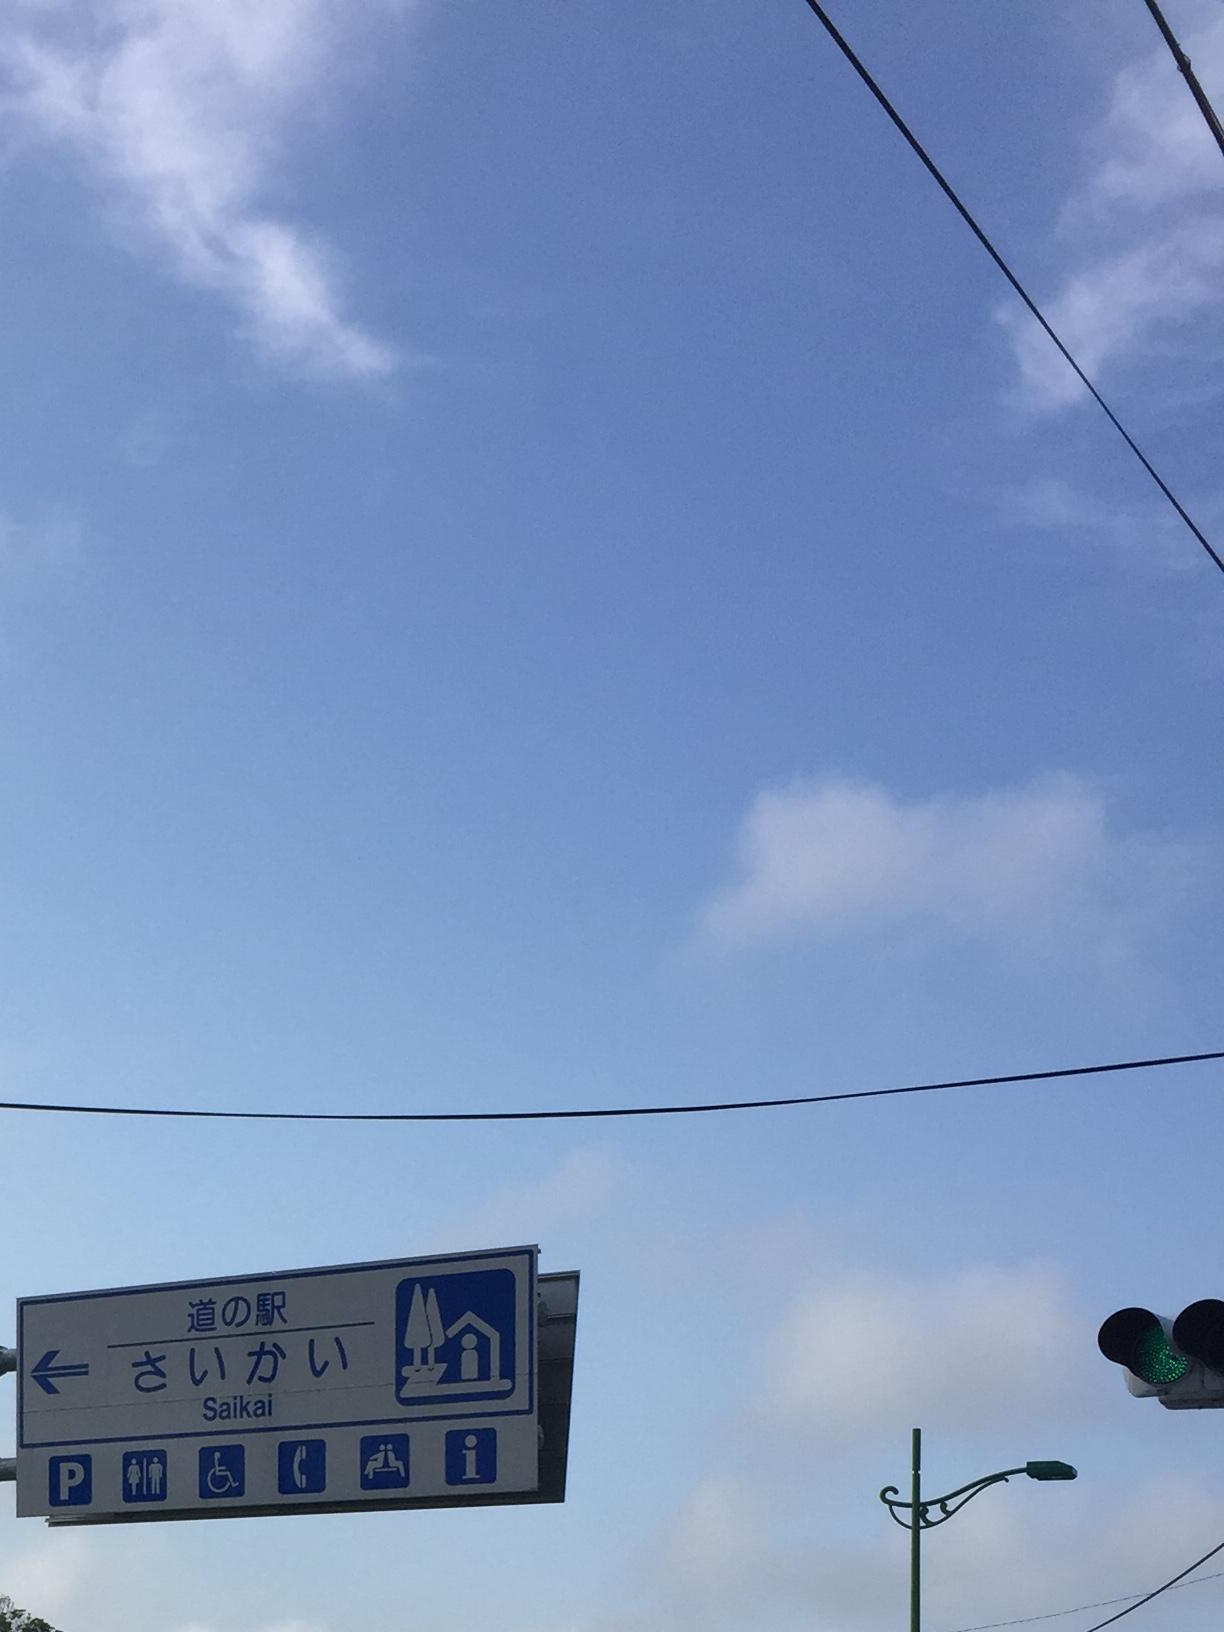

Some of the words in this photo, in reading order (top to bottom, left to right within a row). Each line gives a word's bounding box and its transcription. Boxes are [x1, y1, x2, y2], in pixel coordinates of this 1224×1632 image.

[187, 1291, 288, 1332] 道の駅
[131, 1336, 349, 1393] さいかい
[202, 1393, 273, 1421] Saikai
[59, 1461, 85, 1500] P
